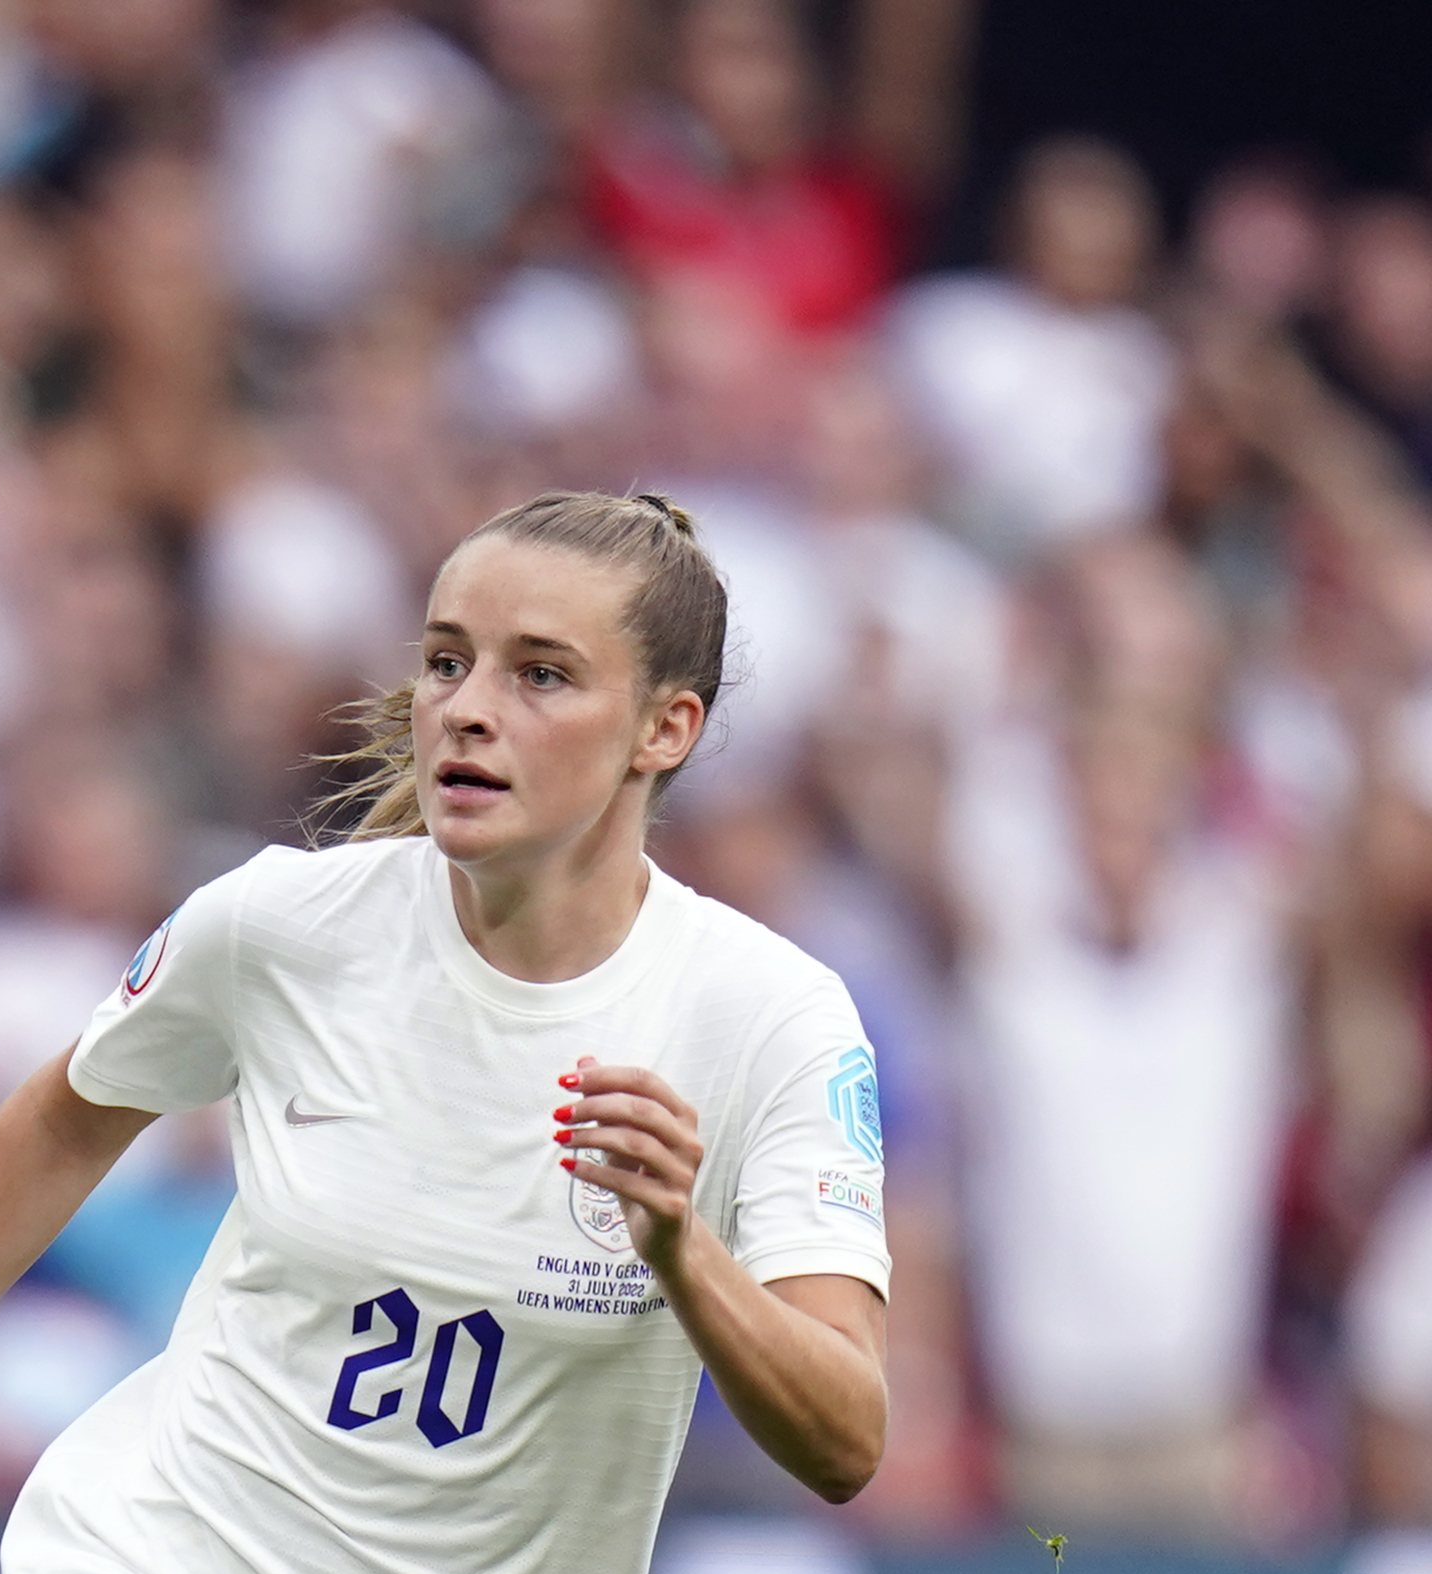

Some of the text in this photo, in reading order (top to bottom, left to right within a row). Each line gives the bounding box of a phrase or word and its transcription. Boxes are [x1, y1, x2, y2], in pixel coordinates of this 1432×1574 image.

[818, 1169, 849, 1183] UEFA
[537, 1255, 658, 1280] ENGLAND V GERM
[568, 1279, 646, 1299] 31 JULY 2022
[517, 1289, 670, 1316] UEFA WOMENS EURO FIN
[327, 1287, 505, 1449] 20
